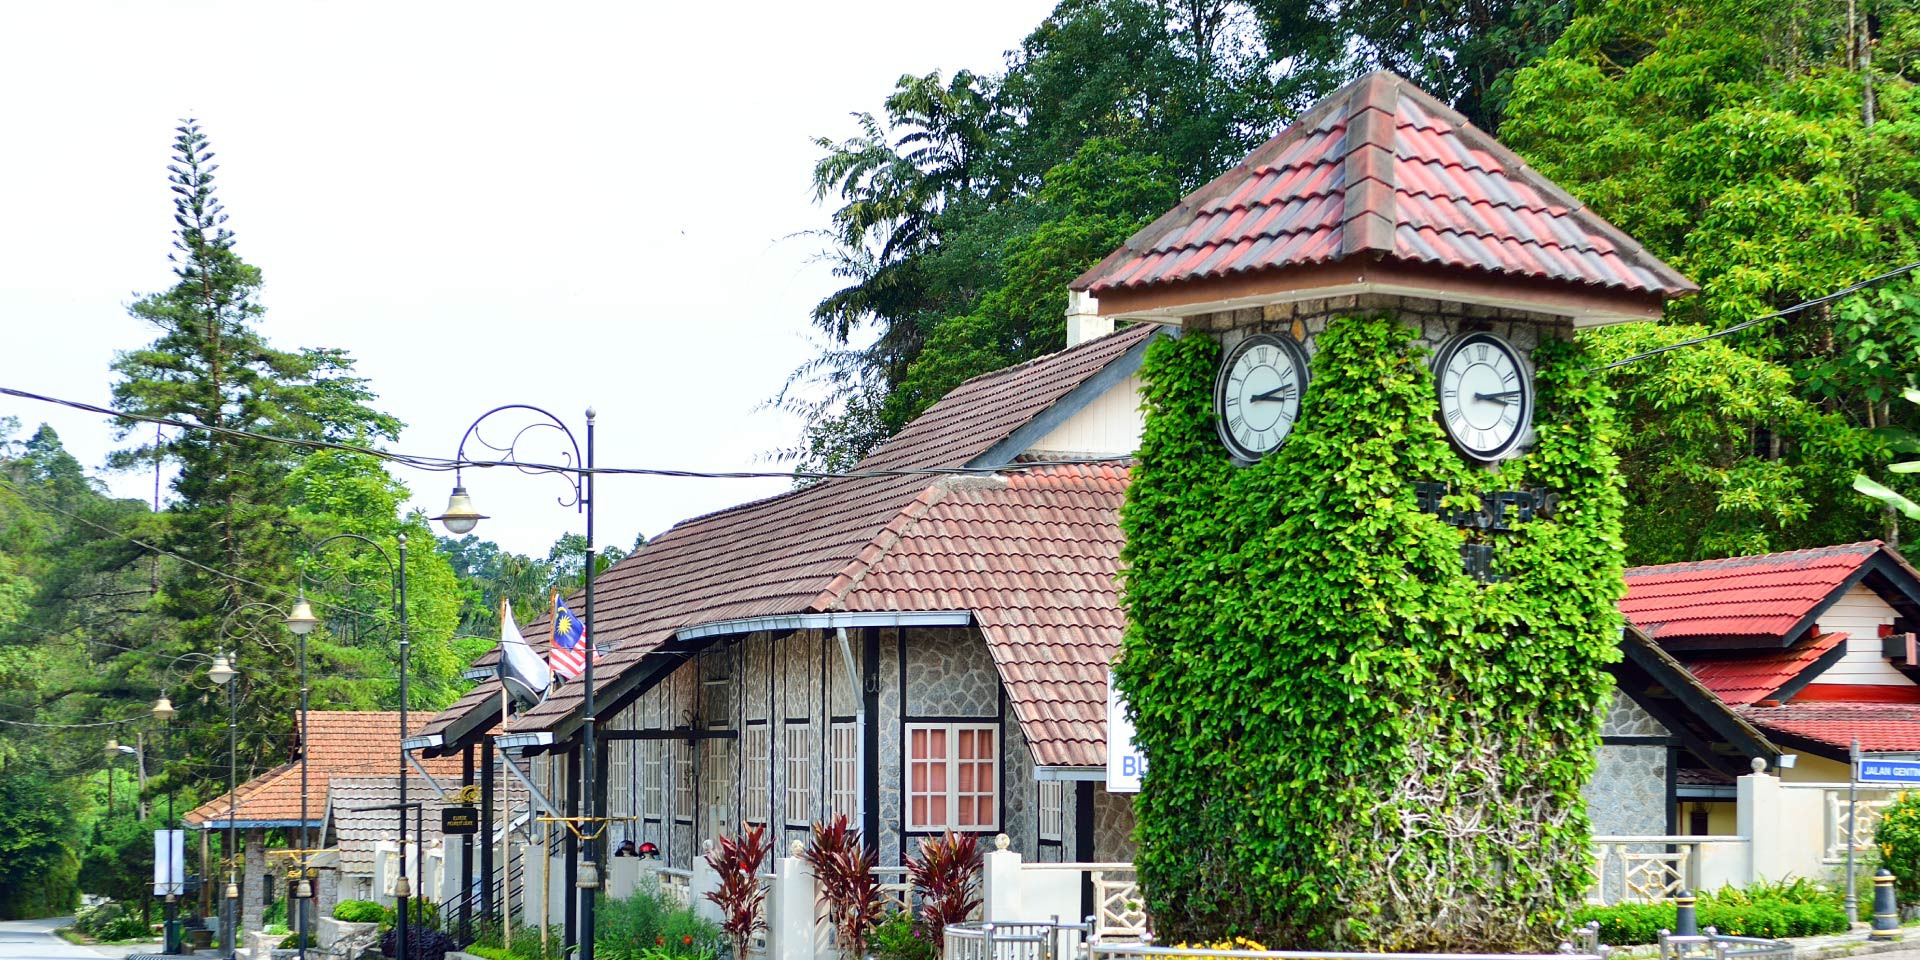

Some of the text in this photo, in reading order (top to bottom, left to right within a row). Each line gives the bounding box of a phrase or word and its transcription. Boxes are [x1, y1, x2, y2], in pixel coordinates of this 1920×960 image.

[1257, 347, 1267, 363] XII
[1273, 352, 1280, 366] I
[1477, 345, 1489, 361] XII
[1494, 354, 1503, 368] I
[1281, 366, 1292, 379] II
[1503, 371, 1515, 384] II
[1285, 389, 1296, 400] III
[1506, 395, 1519, 406] III
[1864, 766, 1891, 776] JALAN
